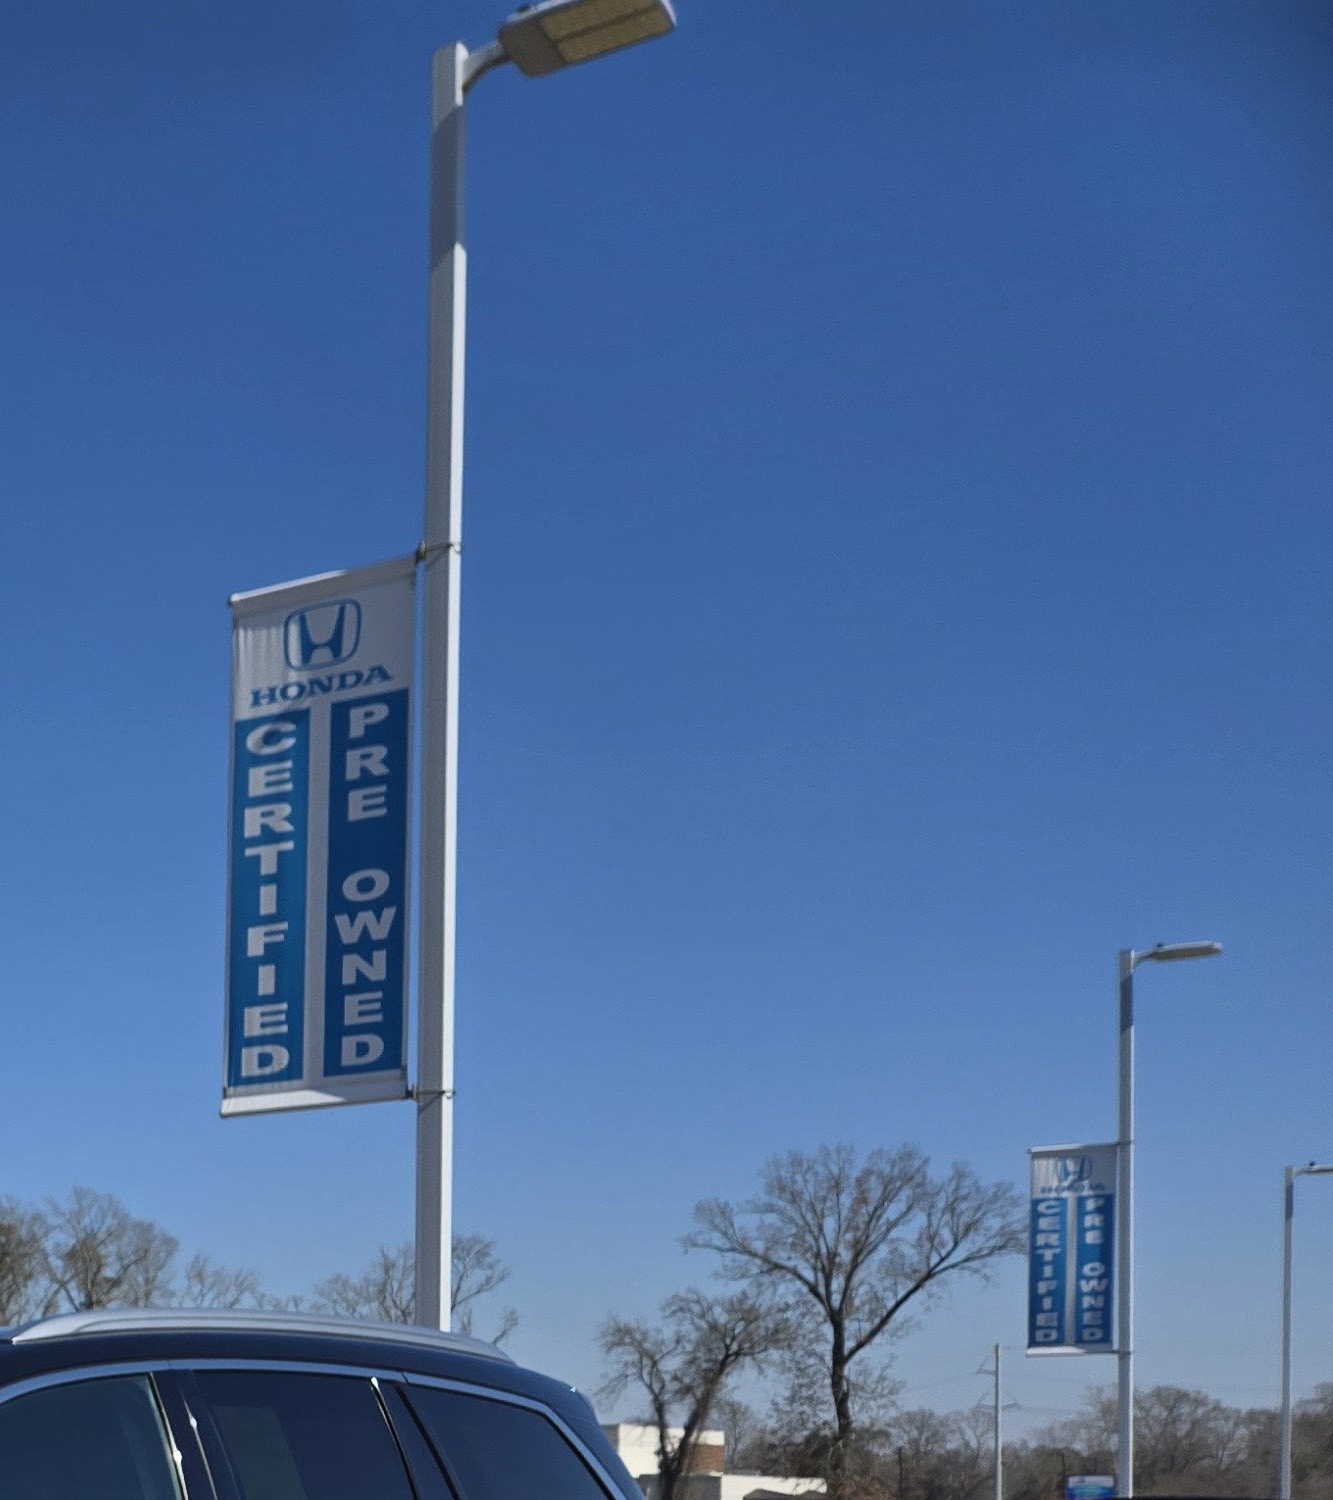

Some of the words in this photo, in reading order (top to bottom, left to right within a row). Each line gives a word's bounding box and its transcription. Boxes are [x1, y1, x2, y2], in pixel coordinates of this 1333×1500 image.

[250, 664, 394, 708] HONDA
[346, 703, 390, 822] PRE
[241, 720, 298, 1078] CERTIFIED
[334, 867, 397, 1067] OWNED
